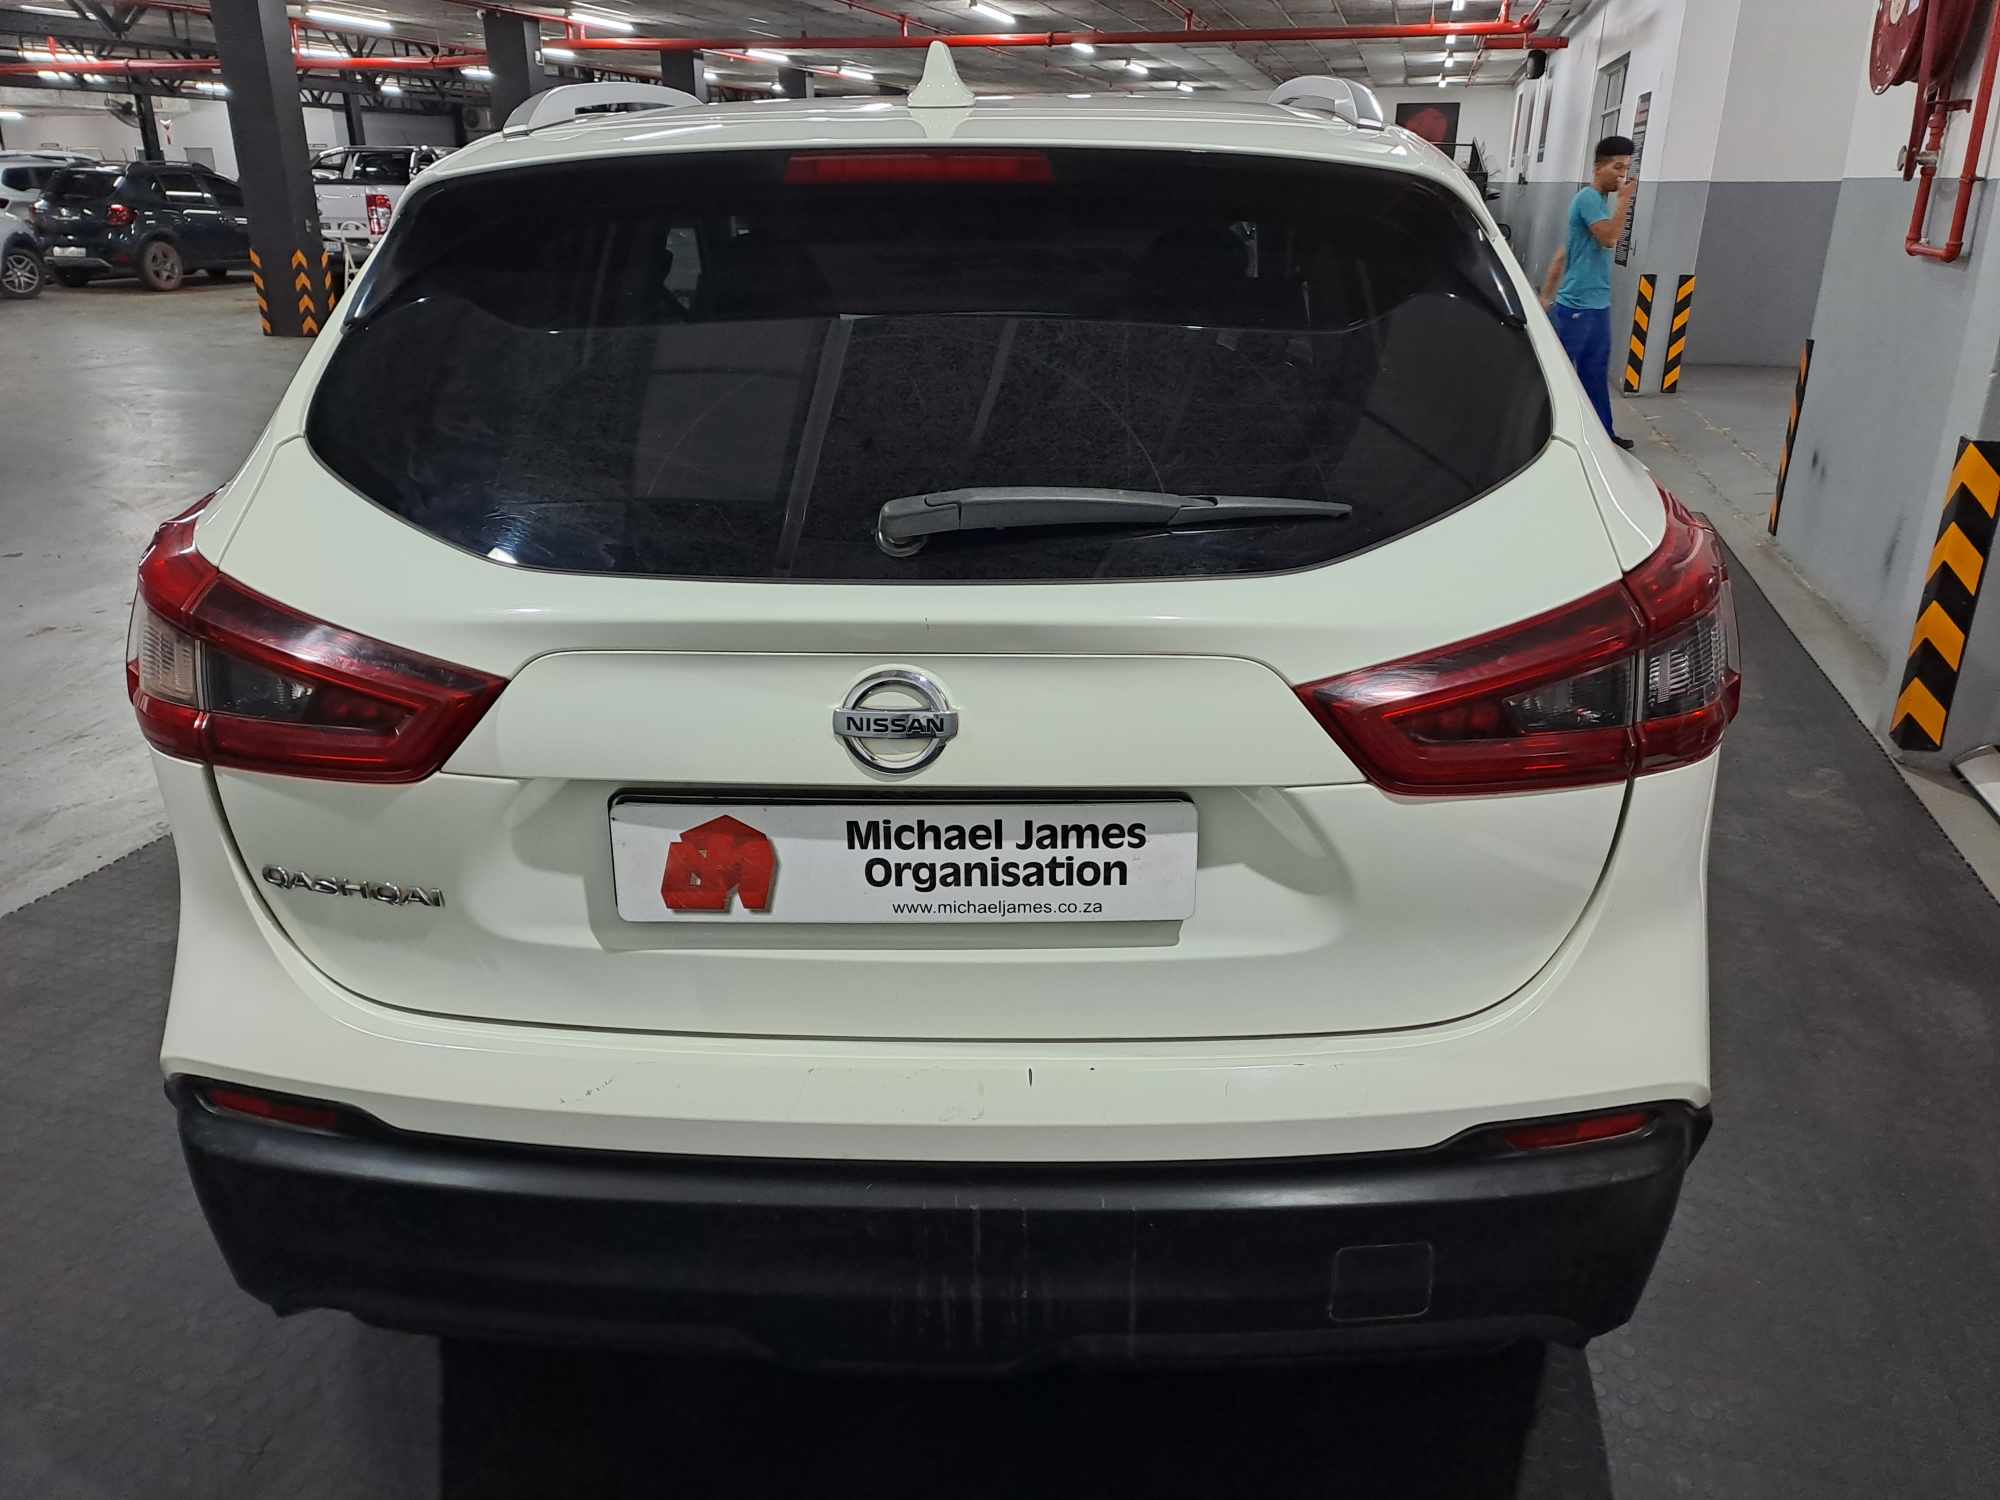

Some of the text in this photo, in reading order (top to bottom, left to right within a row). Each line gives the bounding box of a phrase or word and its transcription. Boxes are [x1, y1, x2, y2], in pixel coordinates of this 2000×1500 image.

[846, 716, 945, 733] NISSAN
[846, 818, 1147, 851] Michael James
[262, 865, 445, 908] QASHQAI
[864, 857, 1128, 892] Organisation
[892, 901, 1103, 917] www.michaeljames.co.za
